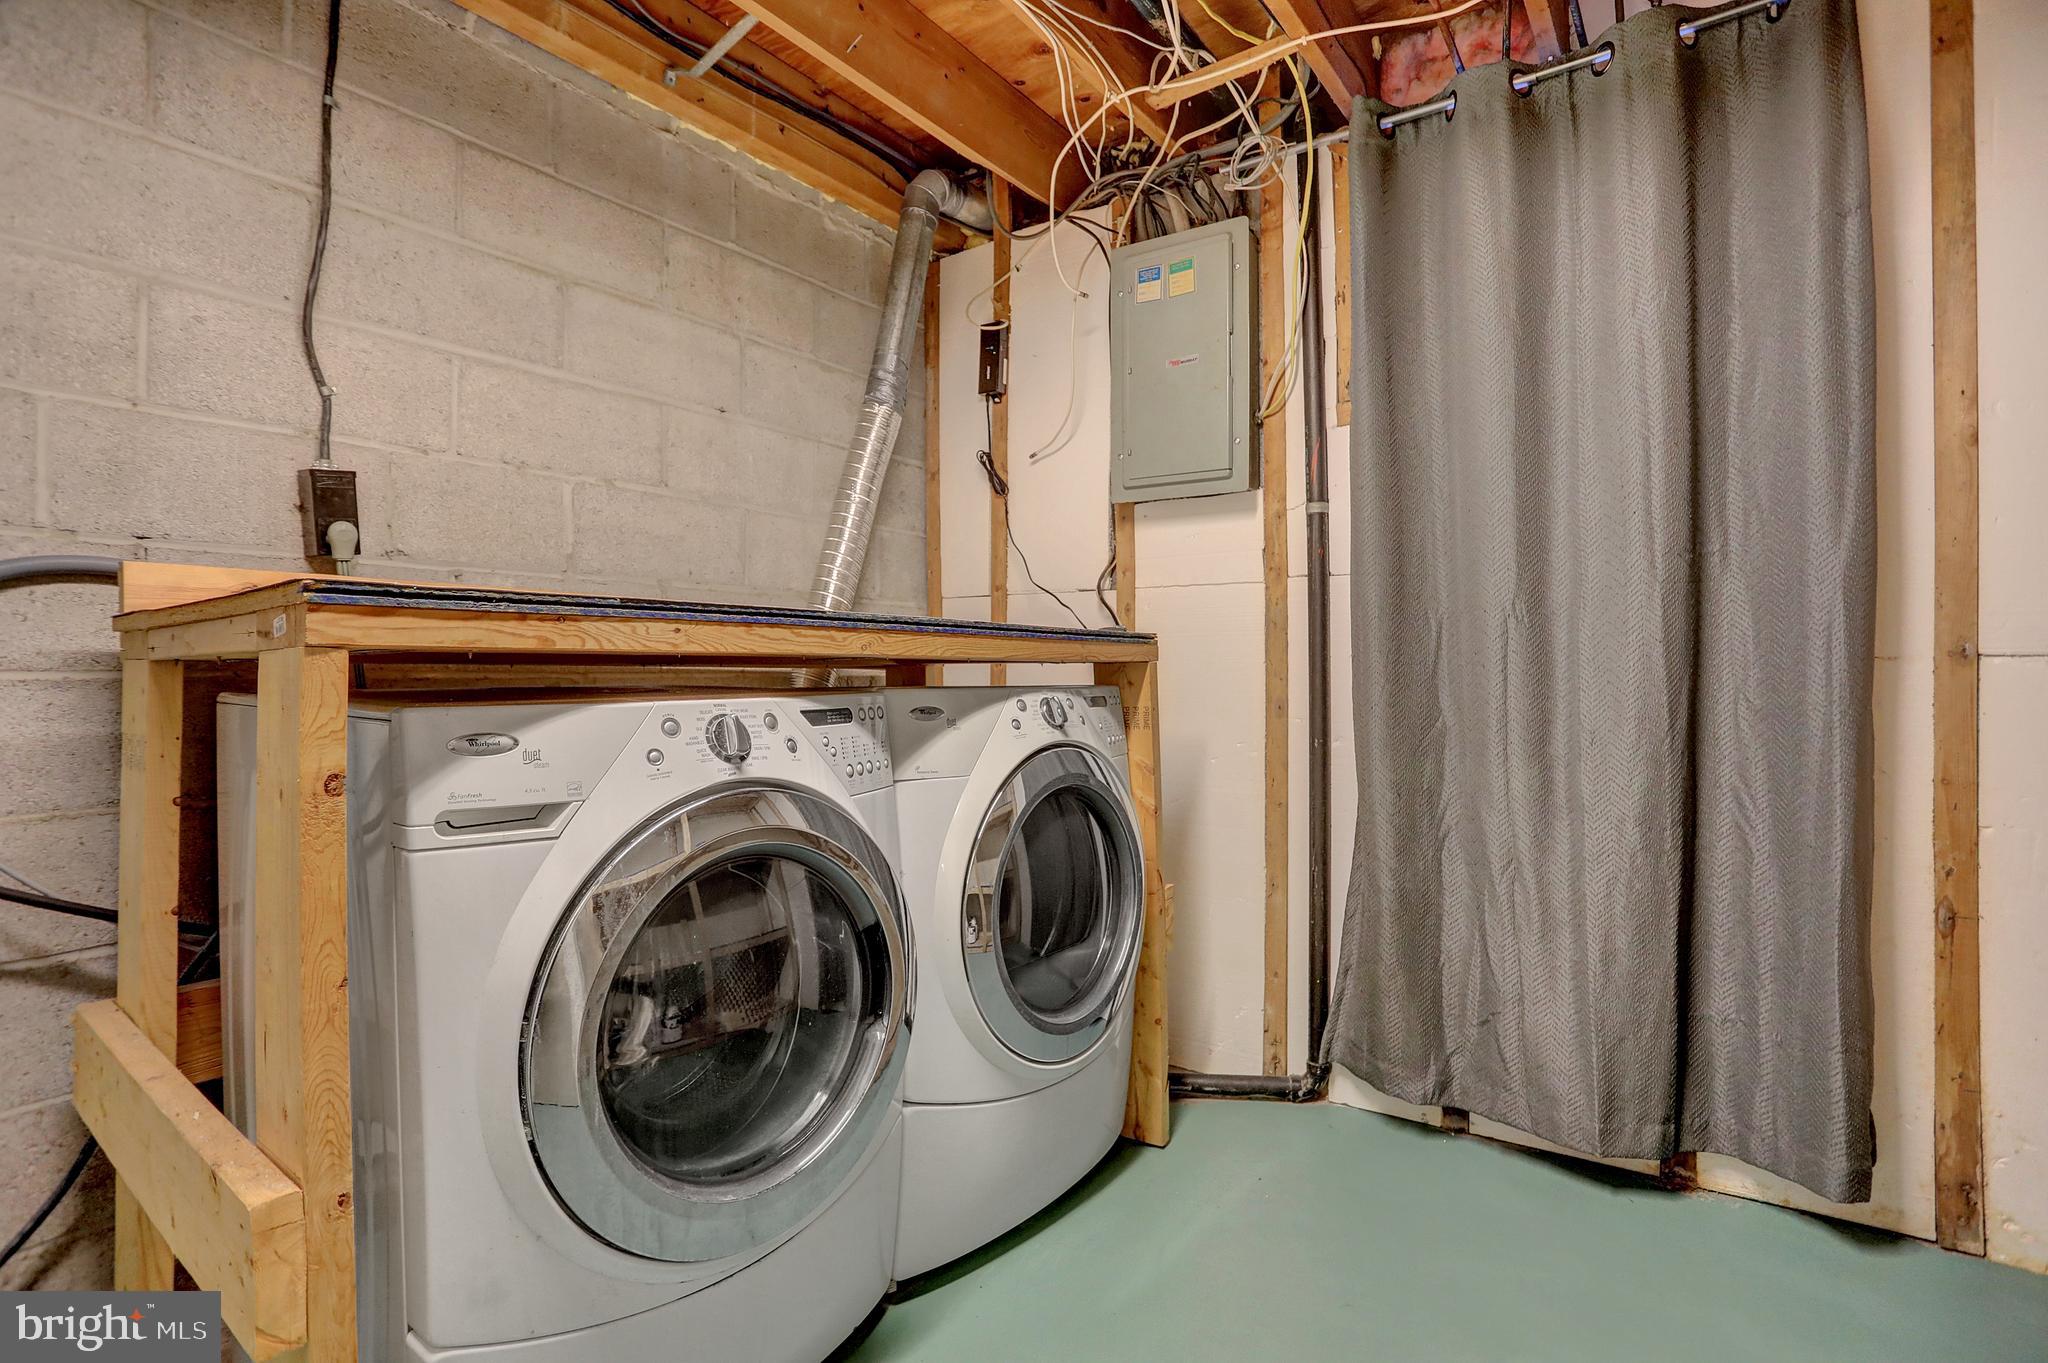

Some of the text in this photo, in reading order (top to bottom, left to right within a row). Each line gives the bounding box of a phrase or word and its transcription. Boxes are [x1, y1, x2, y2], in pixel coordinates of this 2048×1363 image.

[1143, 706, 1151, 730] PRIME
[466, 738, 501, 748] Whirlpool
[522, 748, 542, 763] duet
